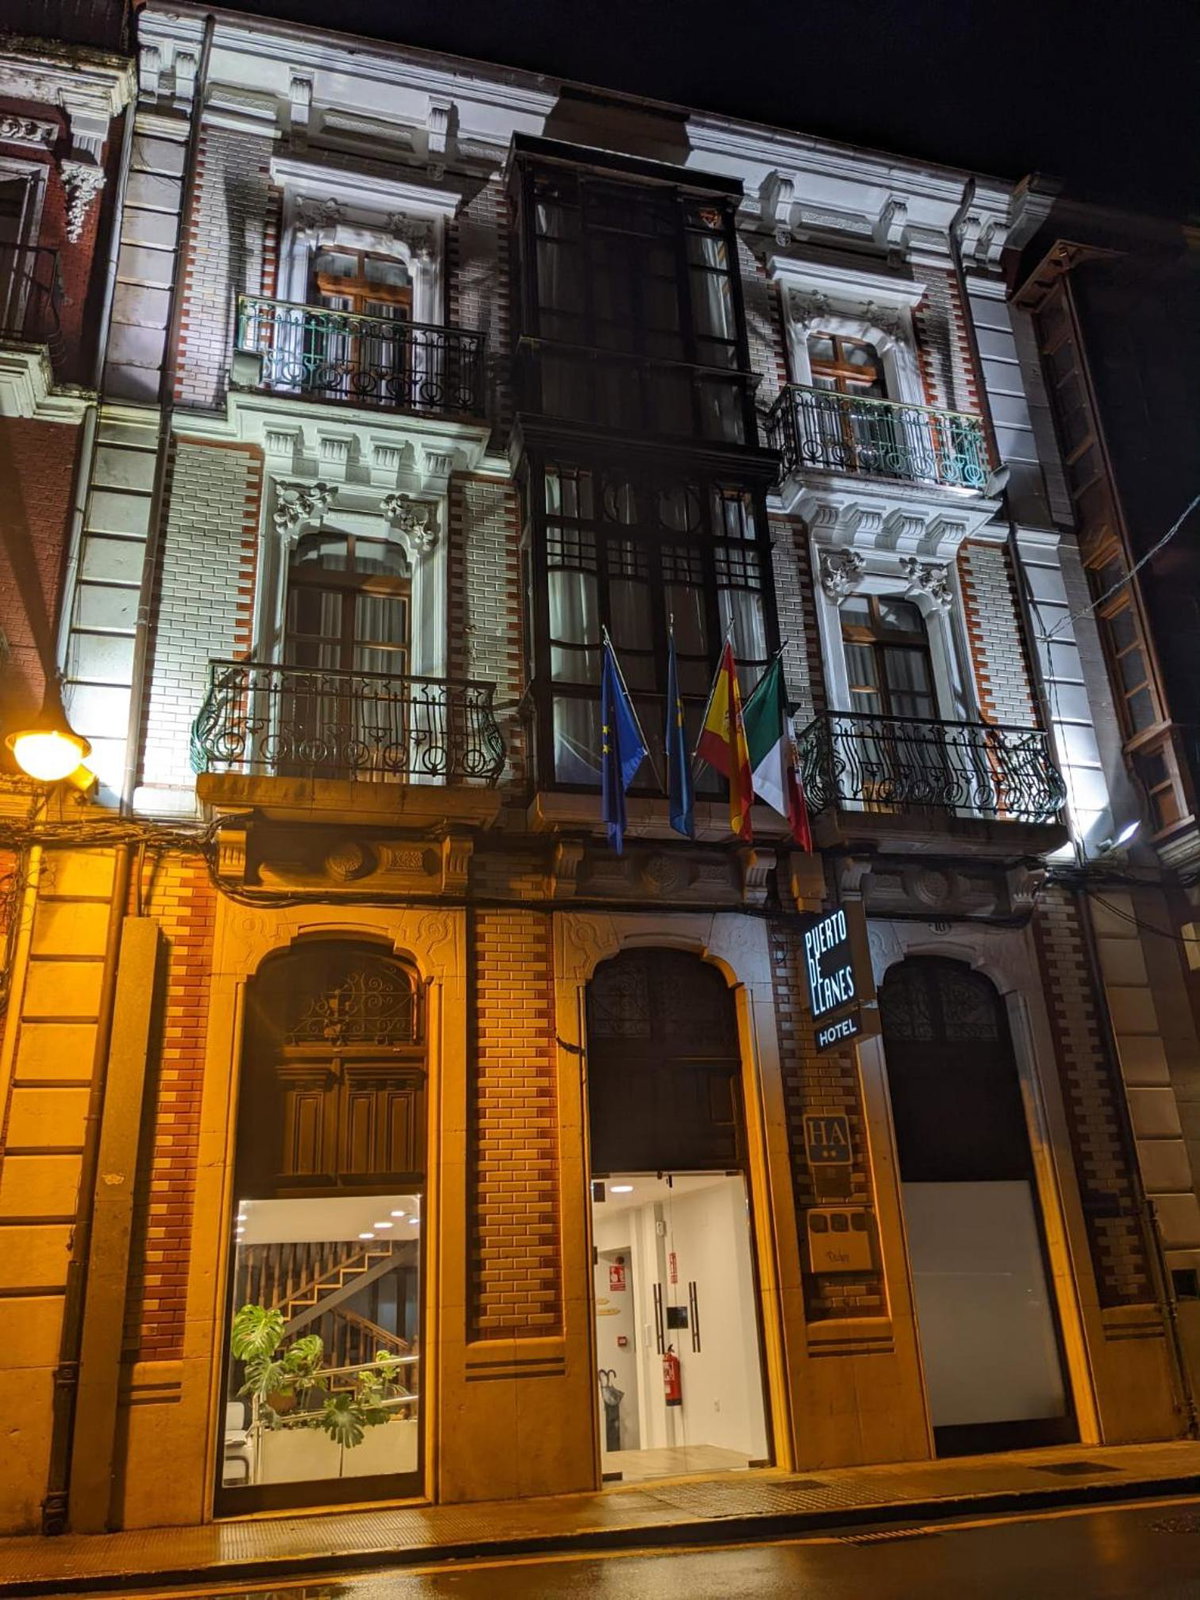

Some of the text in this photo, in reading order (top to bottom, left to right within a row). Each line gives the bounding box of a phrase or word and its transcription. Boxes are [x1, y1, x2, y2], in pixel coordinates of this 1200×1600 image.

[805, 909, 847, 957] PUERTO
[808, 954, 823, 988] DE
[811, 965, 855, 1016] LLANES
[819, 1018, 858, 1046] HOTEL
[807, 1120, 848, 1145] HA
